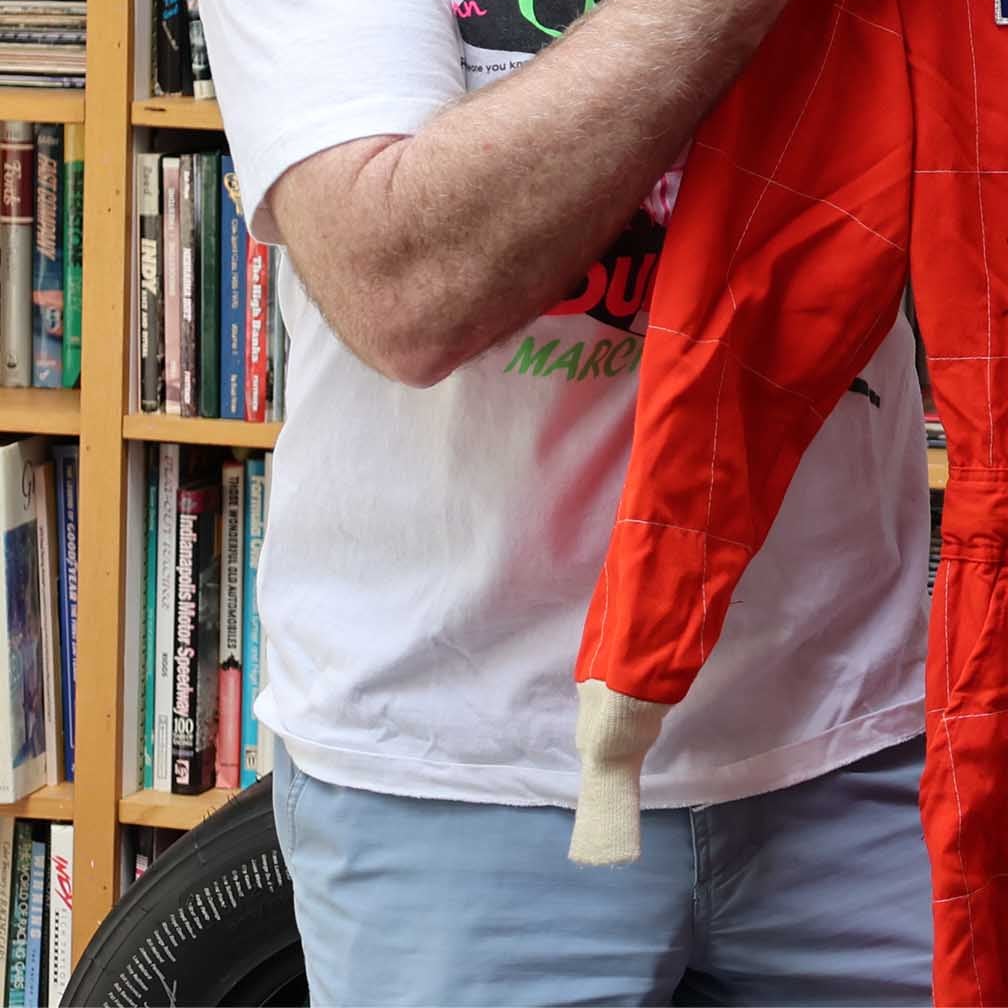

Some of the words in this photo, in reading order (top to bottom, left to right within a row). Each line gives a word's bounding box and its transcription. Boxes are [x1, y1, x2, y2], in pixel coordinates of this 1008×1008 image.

[140, 238, 157, 296] INDY
[252, 255, 263, 282] The
[250, 284, 262, 317] High
[251, 319, 262, 363] Banks
[175, 513, 199, 600] Indianapolis
[227, 511, 239, 565] WONDERFUL
[227, 566, 238, 584] OLD
[175, 601, 197, 645] Motor
[226, 585, 238, 649] AUTOMOBILES
[172, 647, 195, 718] Speedway
[173, 718, 194, 734] 100
